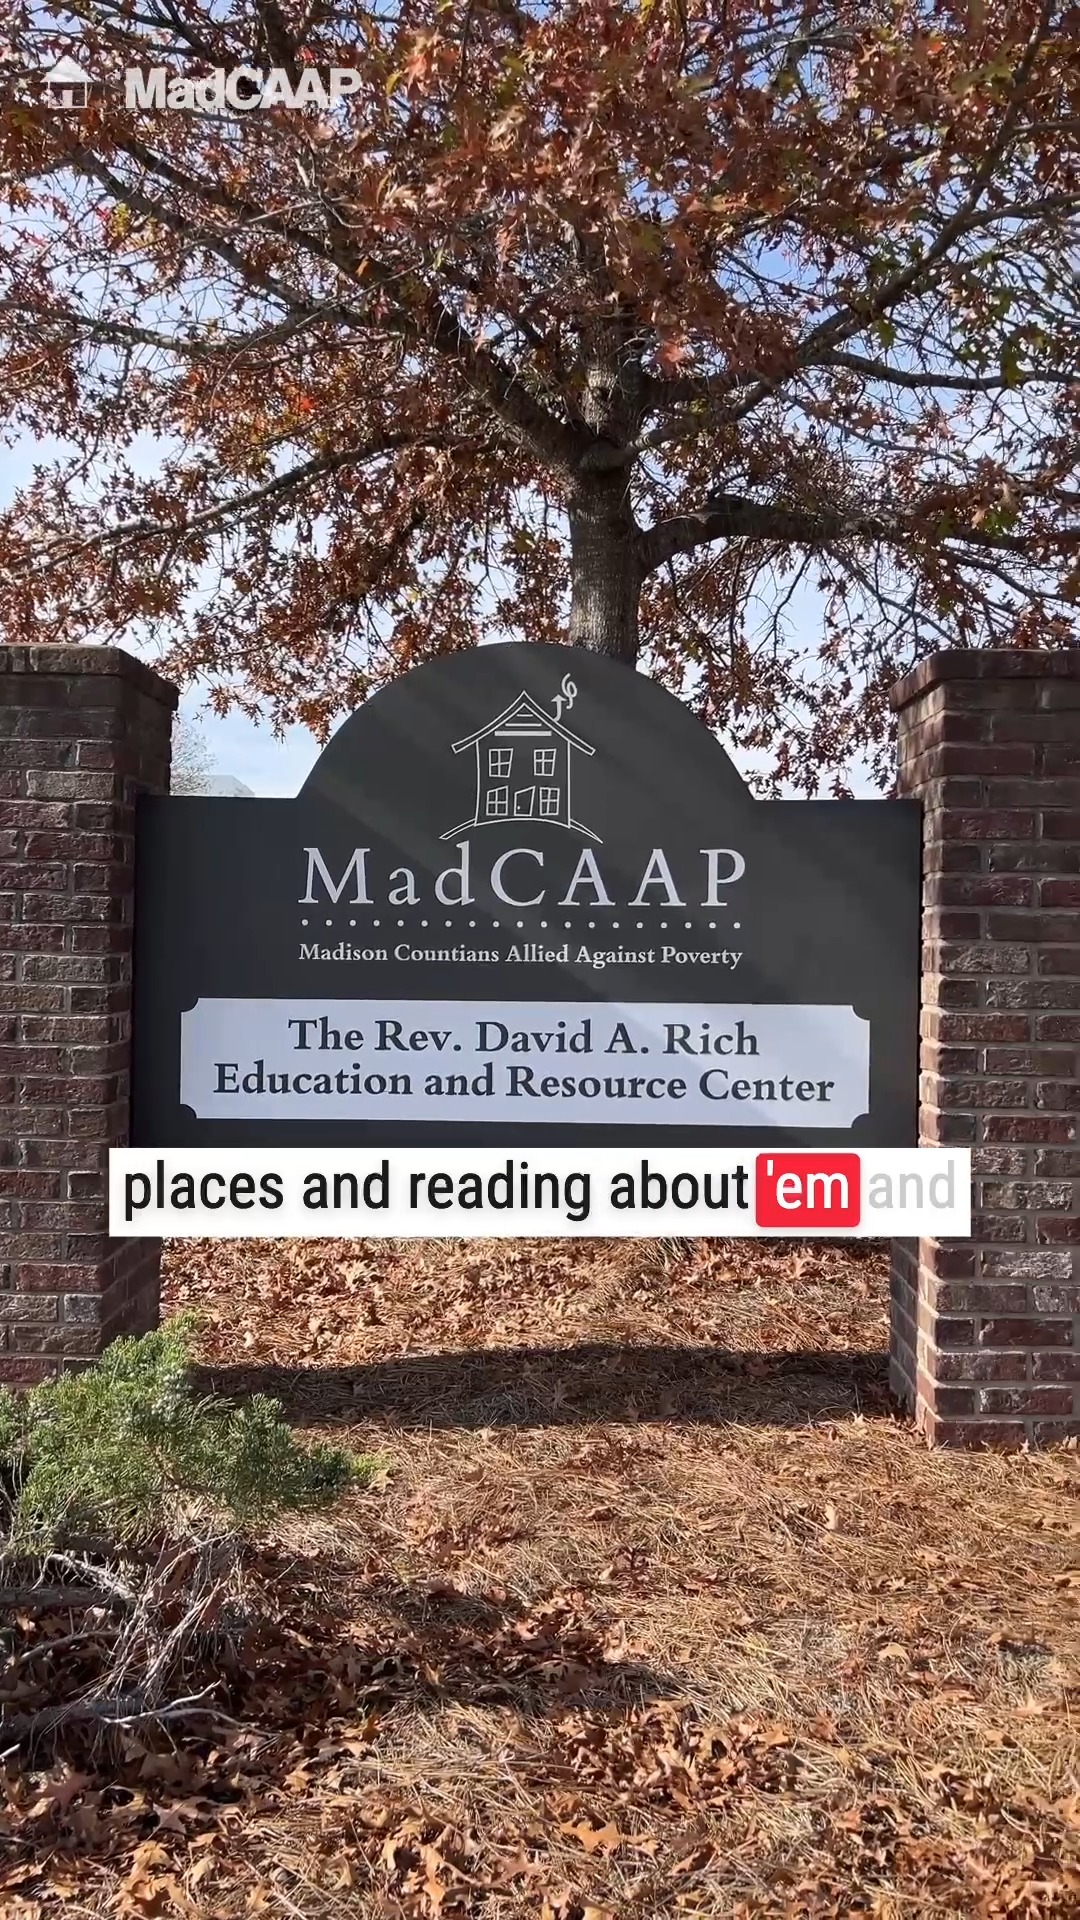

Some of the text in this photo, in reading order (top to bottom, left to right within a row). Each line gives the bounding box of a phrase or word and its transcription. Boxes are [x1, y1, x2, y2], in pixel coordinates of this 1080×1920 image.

[297, 840, 746, 908] MadCAAP
[298, 941, 743, 970] Madison Countians Allied Against Poverty
[287, 1015, 760, 1056] The Rev. David A. Rich
[212, 1060, 835, 1102] Education and Resource Center
